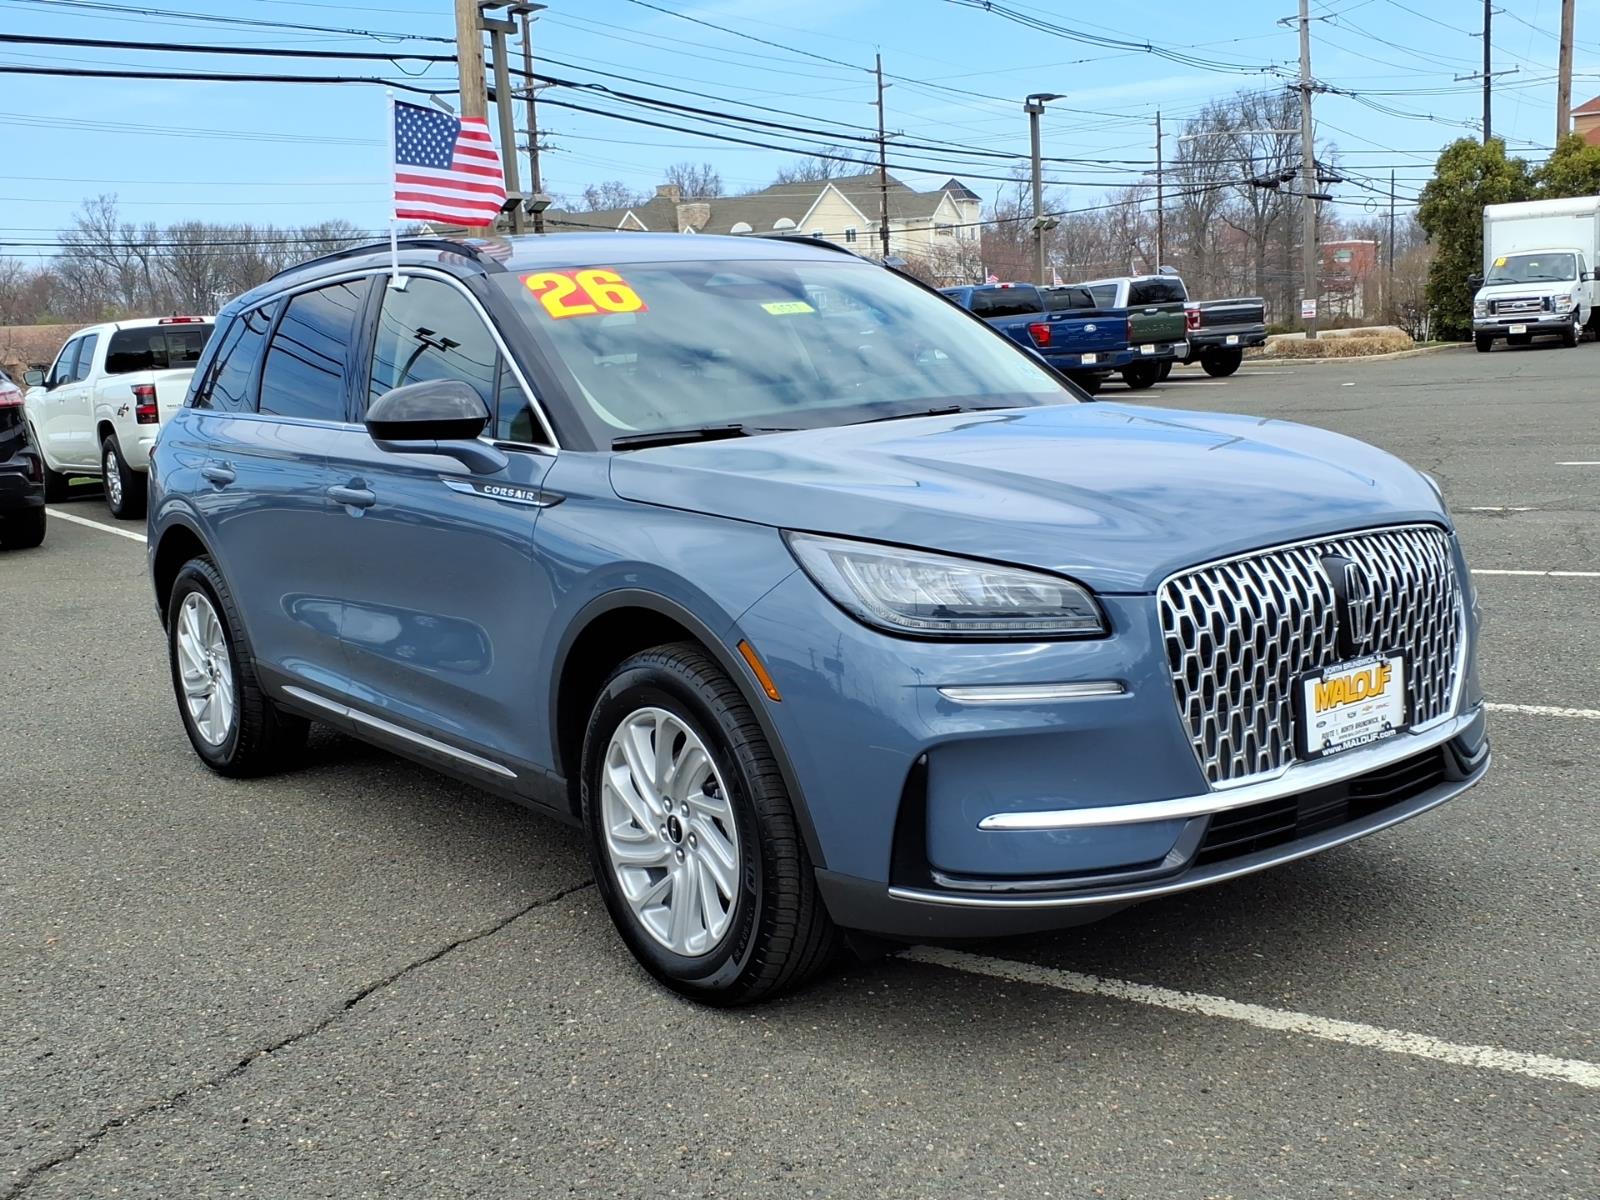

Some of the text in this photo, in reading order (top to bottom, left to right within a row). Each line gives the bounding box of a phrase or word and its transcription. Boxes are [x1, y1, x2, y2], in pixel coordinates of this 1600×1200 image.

[526, 269, 643, 319] 26
[484, 485, 535, 501] CORSAIR
[1314, 663, 1392, 713] MALOUF
[1322, 729, 1397, 756] www.MALOUF.com
